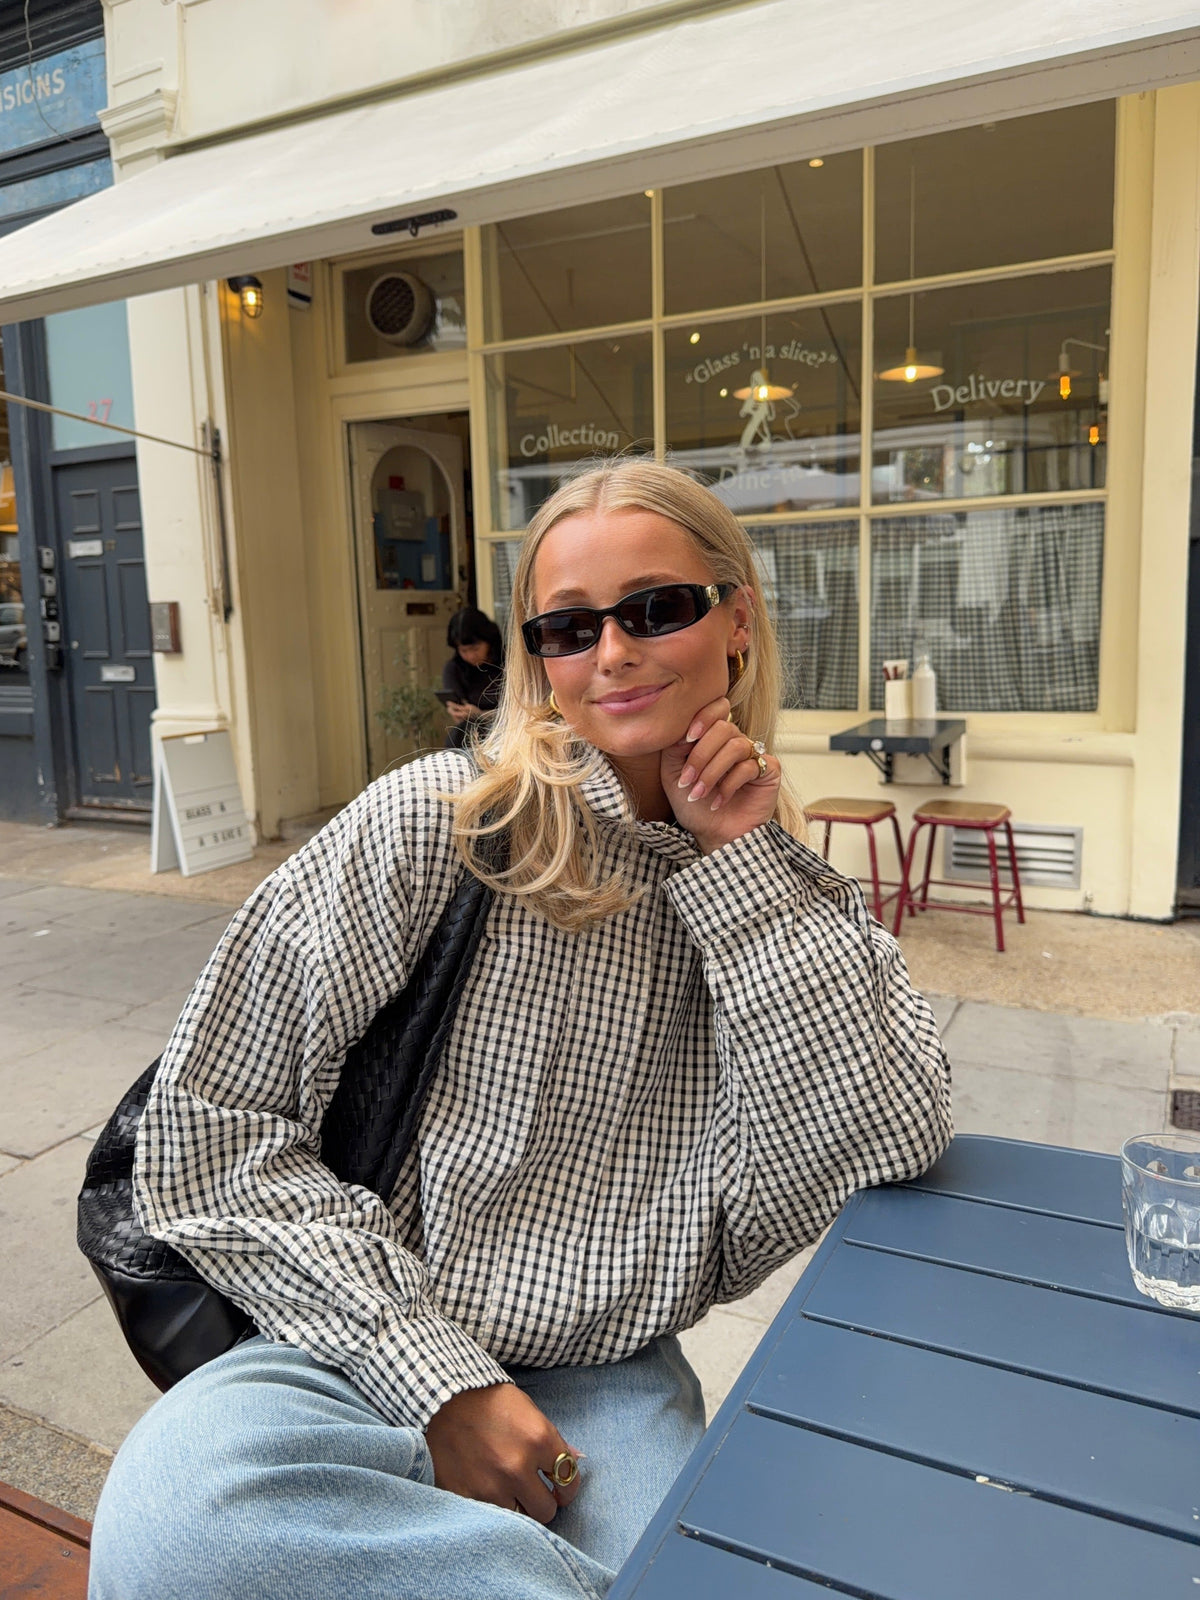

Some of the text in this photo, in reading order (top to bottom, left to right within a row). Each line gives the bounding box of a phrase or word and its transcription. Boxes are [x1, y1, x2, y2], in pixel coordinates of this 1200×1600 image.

[766, 344, 777, 359] a
[930, 373, 1046, 412] Delivery
[88, 399, 113, 423] 27
[520, 423, 619, 457] Collection
